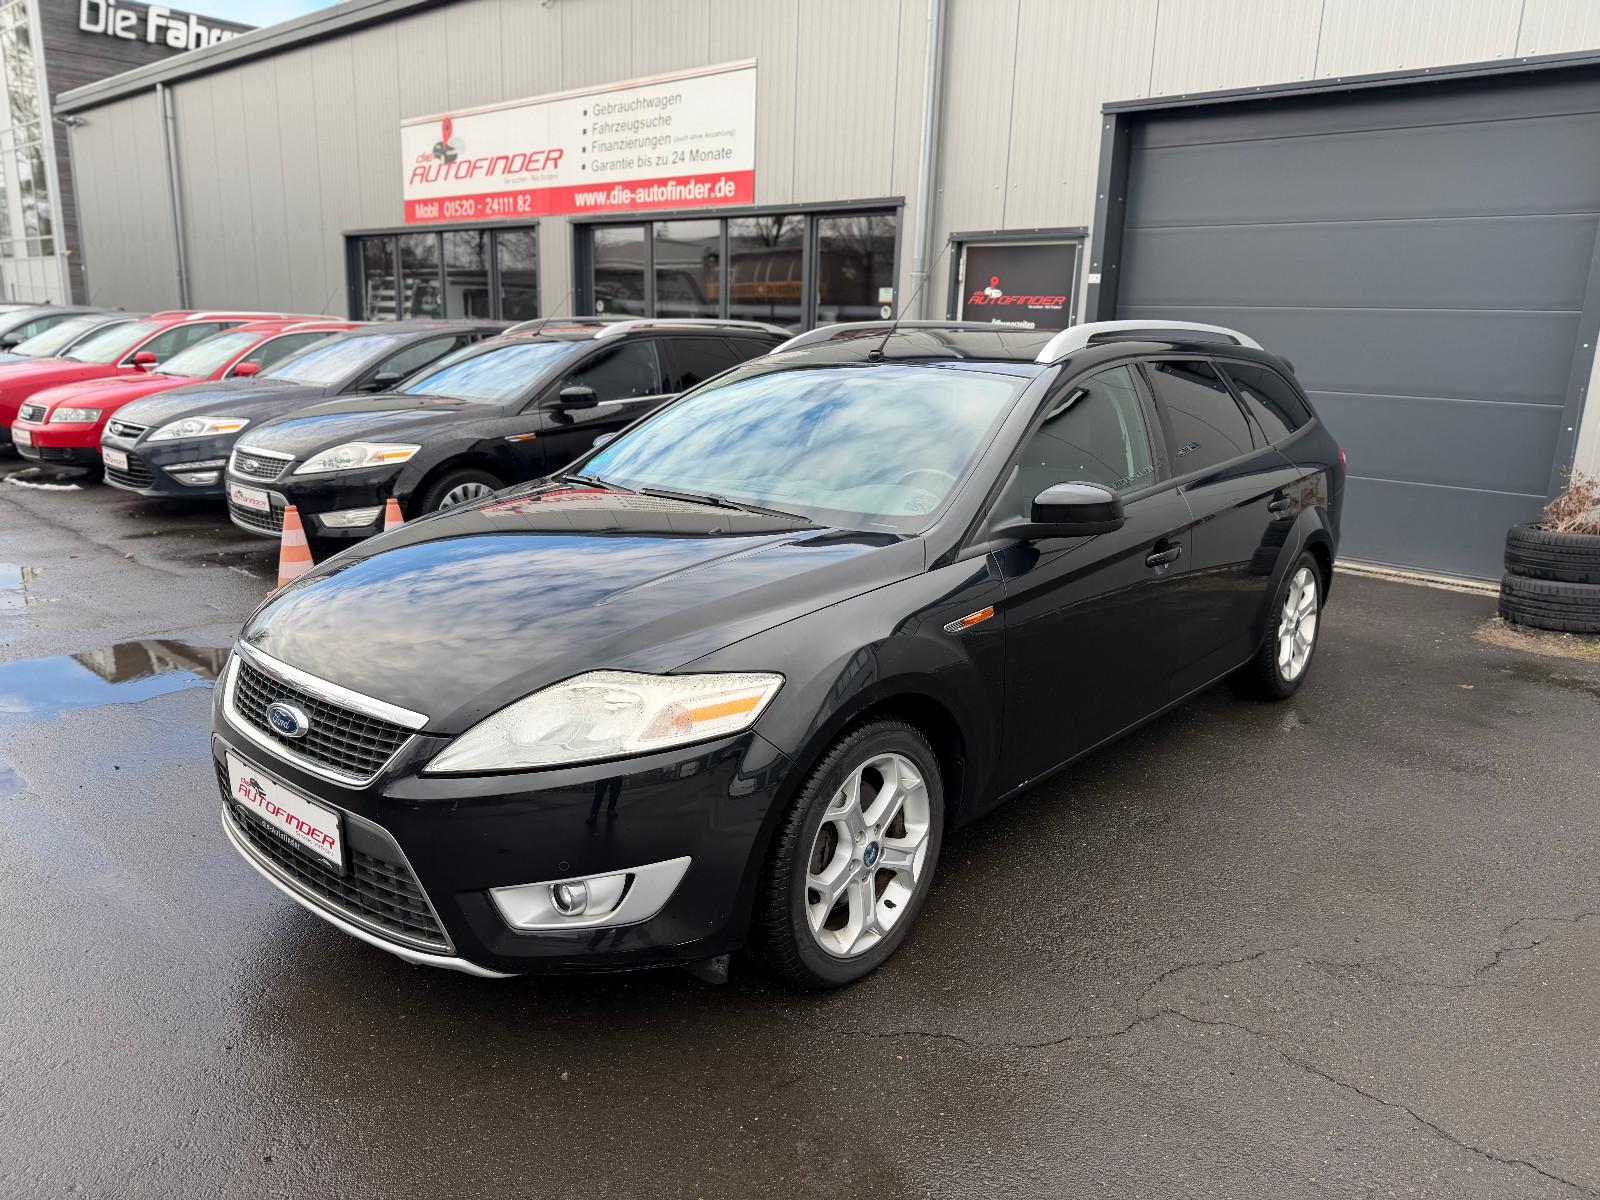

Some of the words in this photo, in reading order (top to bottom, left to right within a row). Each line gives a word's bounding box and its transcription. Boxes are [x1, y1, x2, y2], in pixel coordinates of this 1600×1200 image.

[79, 0, 137, 40] Die
[592, 94, 682, 117] Gebrauchtwagen
[592, 114, 672, 136] Fahrzeugsuche
[591, 134, 672, 153] Finanzierungen
[409, 148, 564, 185] AUTOFINDER
[591, 158, 635, 173] Garantie
[637, 153, 653, 168] bis
[655, 154, 669, 167] zu
[671, 150, 686, 165] 24
[688, 146, 733, 163] Monate
[573, 176, 736, 208] www.die-autofinder.de
[415, 203, 439, 219] Mobil
[443, 199, 475, 217] 01520
[485, 196, 514, 215] 24111
[517, 194, 532, 212] 82
[967, 295, 1067, 305] AUTOFINDER
[272, 709, 291, 730] Ford
[238, 783, 336, 851] AUTOFINDER
